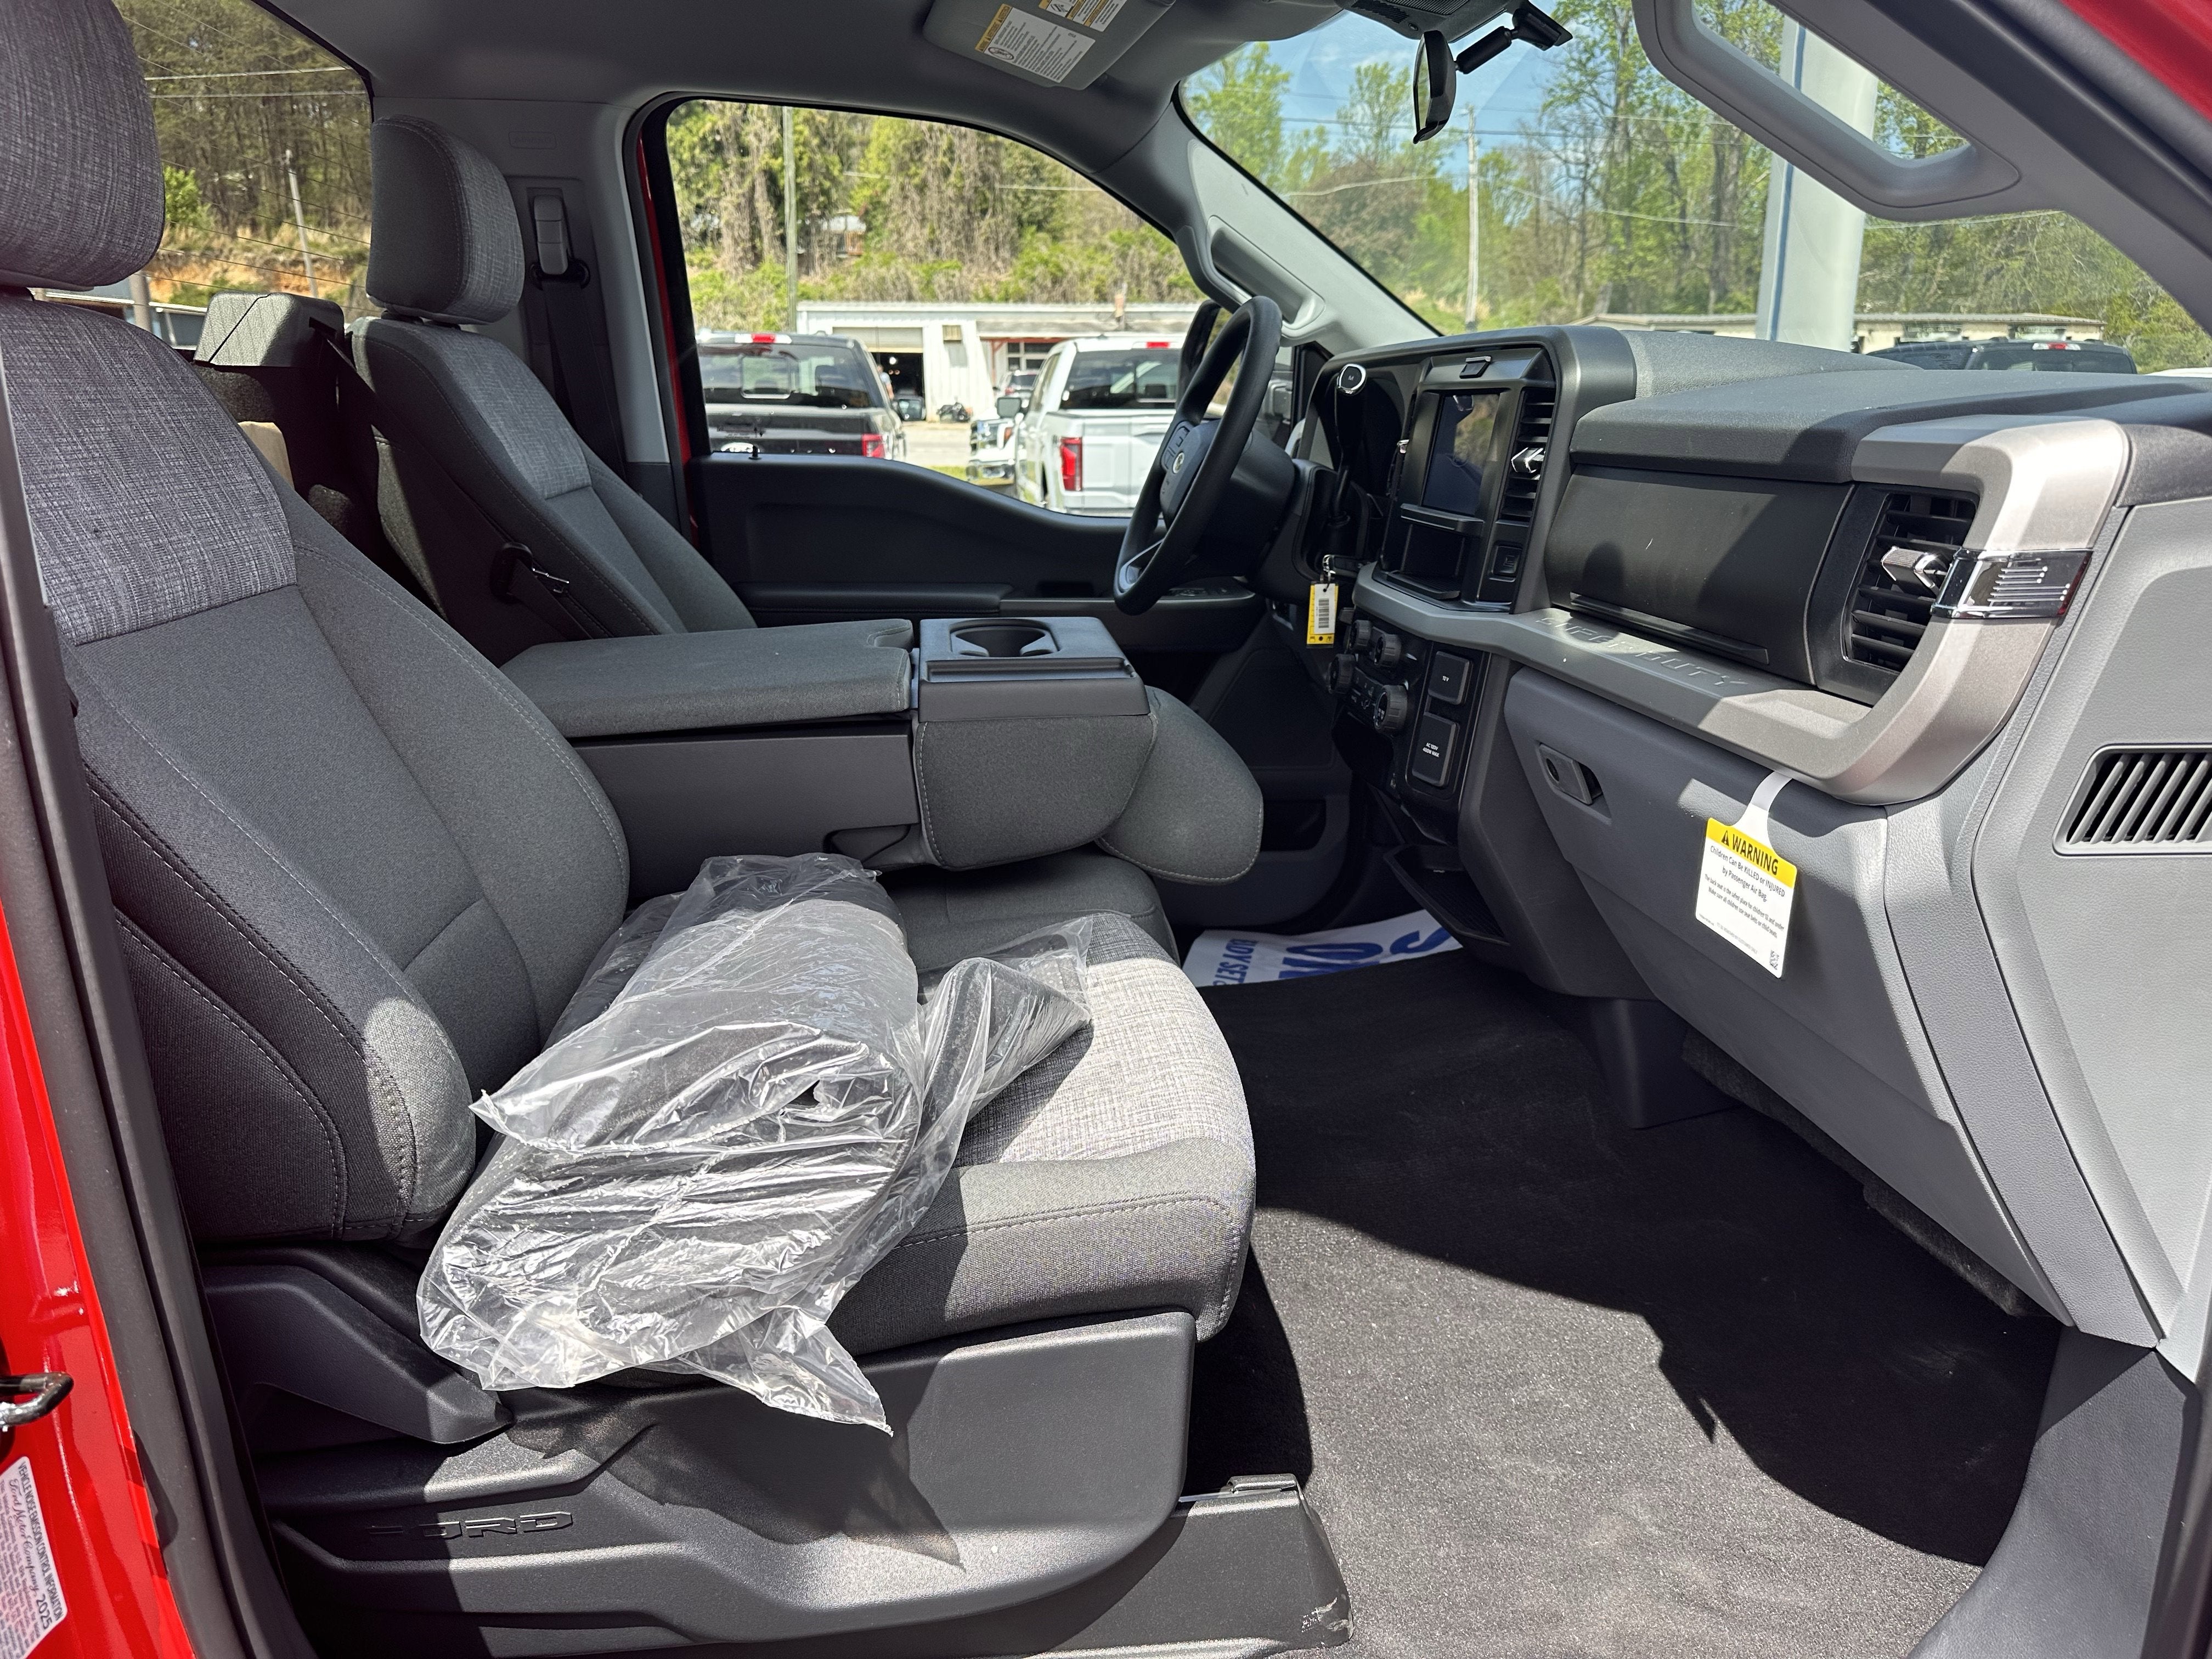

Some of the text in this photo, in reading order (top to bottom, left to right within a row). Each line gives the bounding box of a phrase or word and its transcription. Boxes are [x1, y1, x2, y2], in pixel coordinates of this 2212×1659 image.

[1634, 651, 1749, 686] DUTY
[1711, 845, 1728, 861] Children
[1738, 862, 1743, 871] Be
[1744, 866, 1759, 881] KILLED
[1765, 880, 1785, 897] INJURED
[1733, 833, 1779, 875] WARNING
[1722, 866, 1728, 877] by
[1729, 870, 1750, 889] Passenger
[1708, 887, 1717, 896] Make
[1728, 899, 1739, 911] children
[1753, 906, 1764, 918] children
[1215, 960, 1249, 984] SET
[9, 1478, 53, 1629] Ford Motor Company 2025
[18, 1462, 64, 1621] VEHICLE NOISE EMISSION CONTROL INFORMATION
